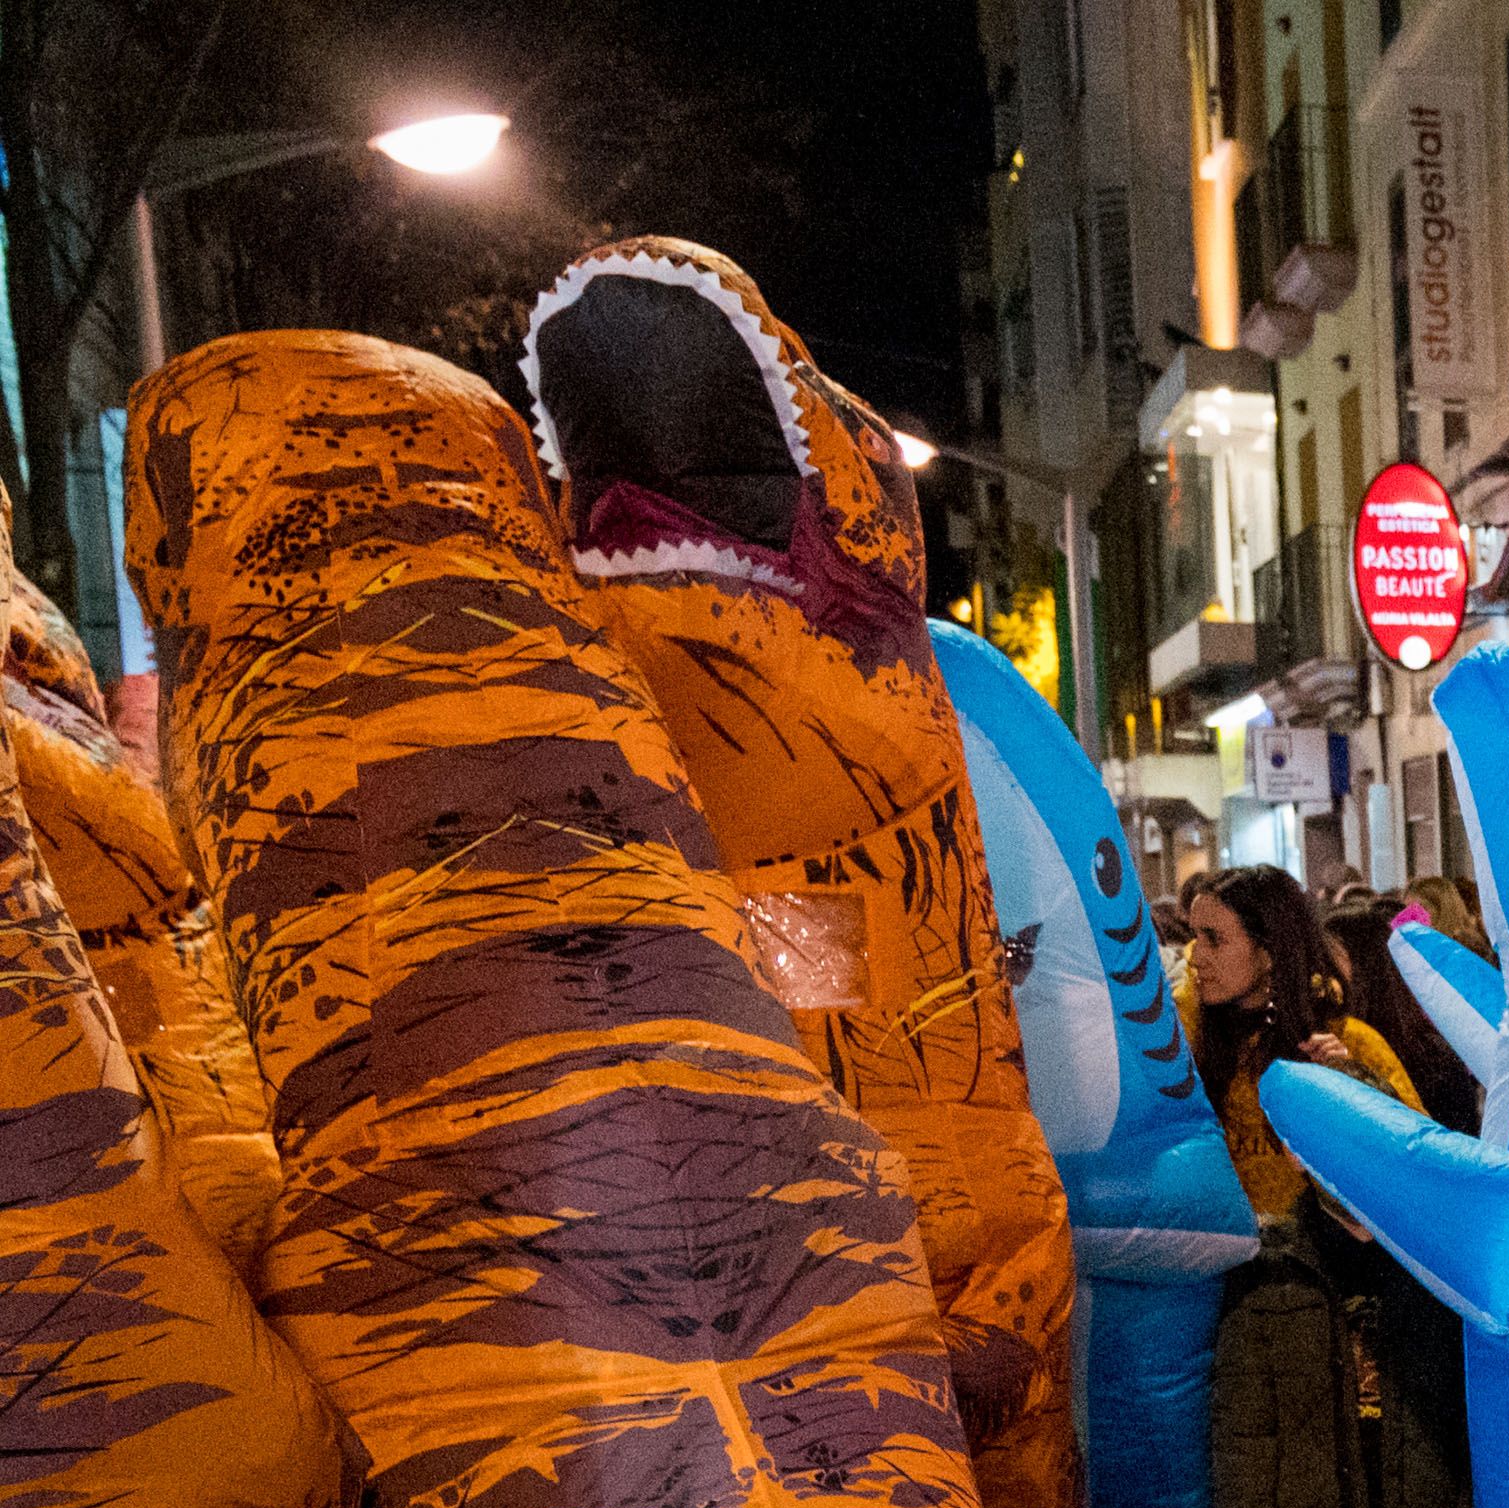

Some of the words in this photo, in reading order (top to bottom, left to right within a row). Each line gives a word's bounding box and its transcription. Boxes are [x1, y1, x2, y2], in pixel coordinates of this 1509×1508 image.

[1408, 104, 1455, 364] studiogestalt
[1362, 545, 1458, 571] PASSION
[1375, 572, 1456, 597] BEAUTÉ
